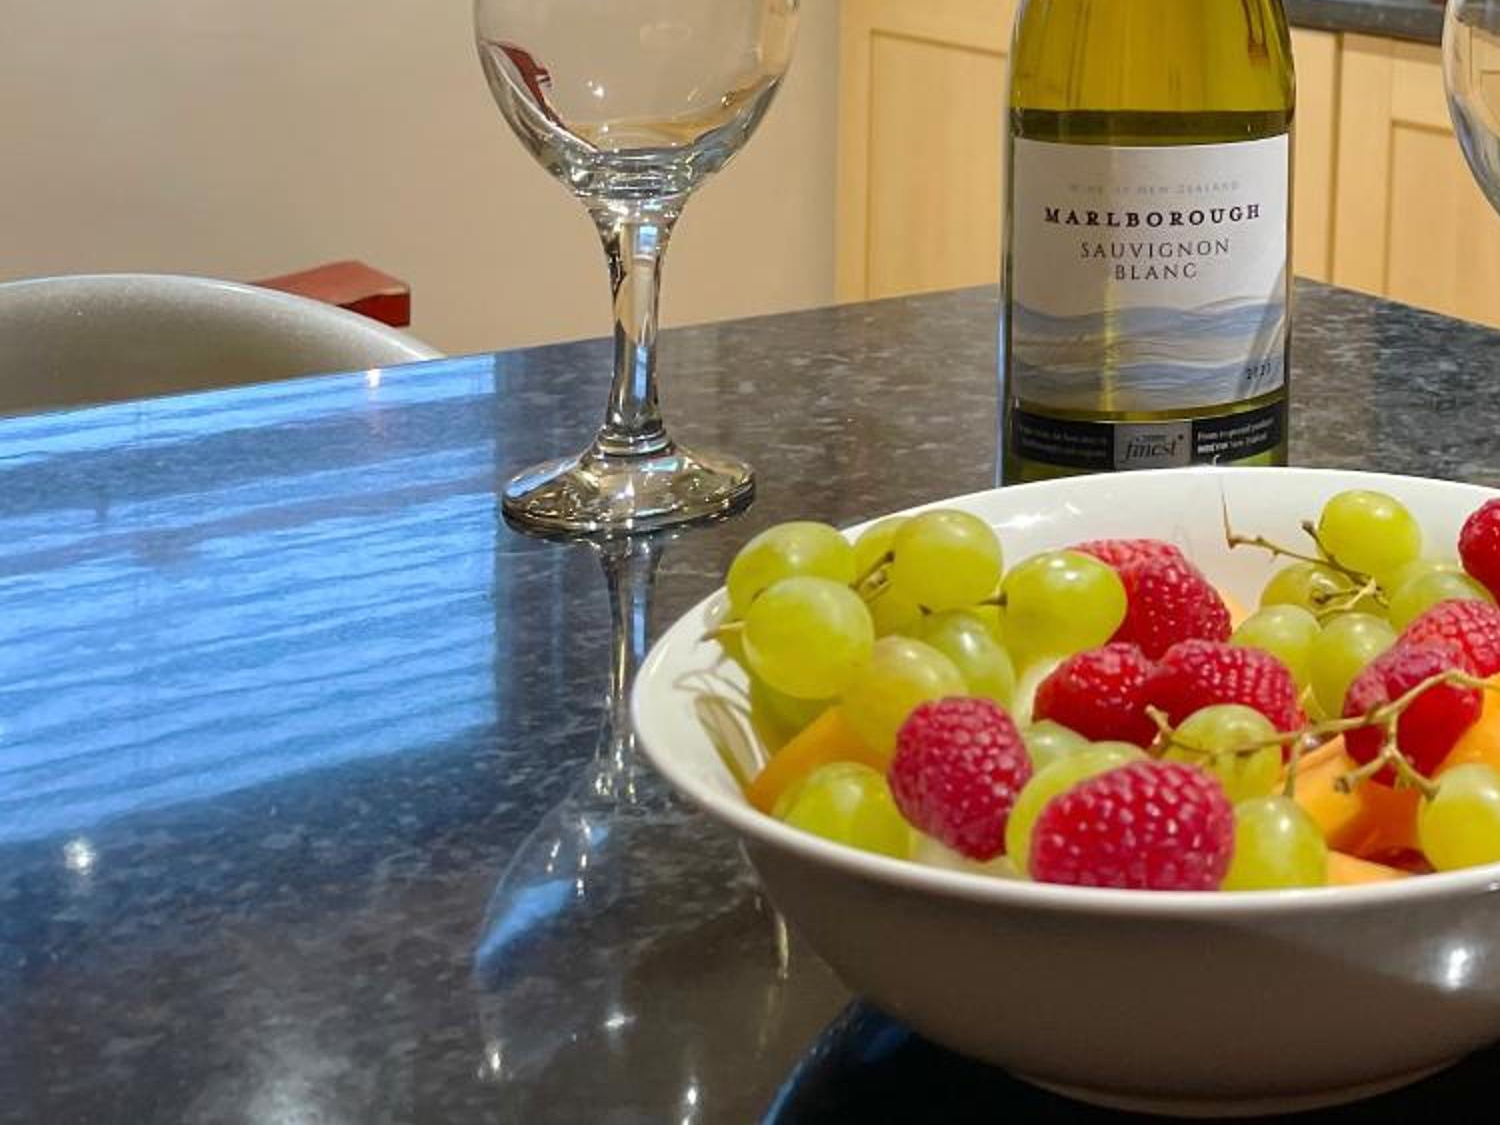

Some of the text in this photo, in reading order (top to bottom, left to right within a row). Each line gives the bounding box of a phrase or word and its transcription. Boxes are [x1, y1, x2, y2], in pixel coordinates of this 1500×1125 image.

[1044, 204, 1261, 227] MARLBOROUGH
[1081, 238, 1230, 258] SAUVIGNON
[1115, 262, 1198, 280] BLANC
